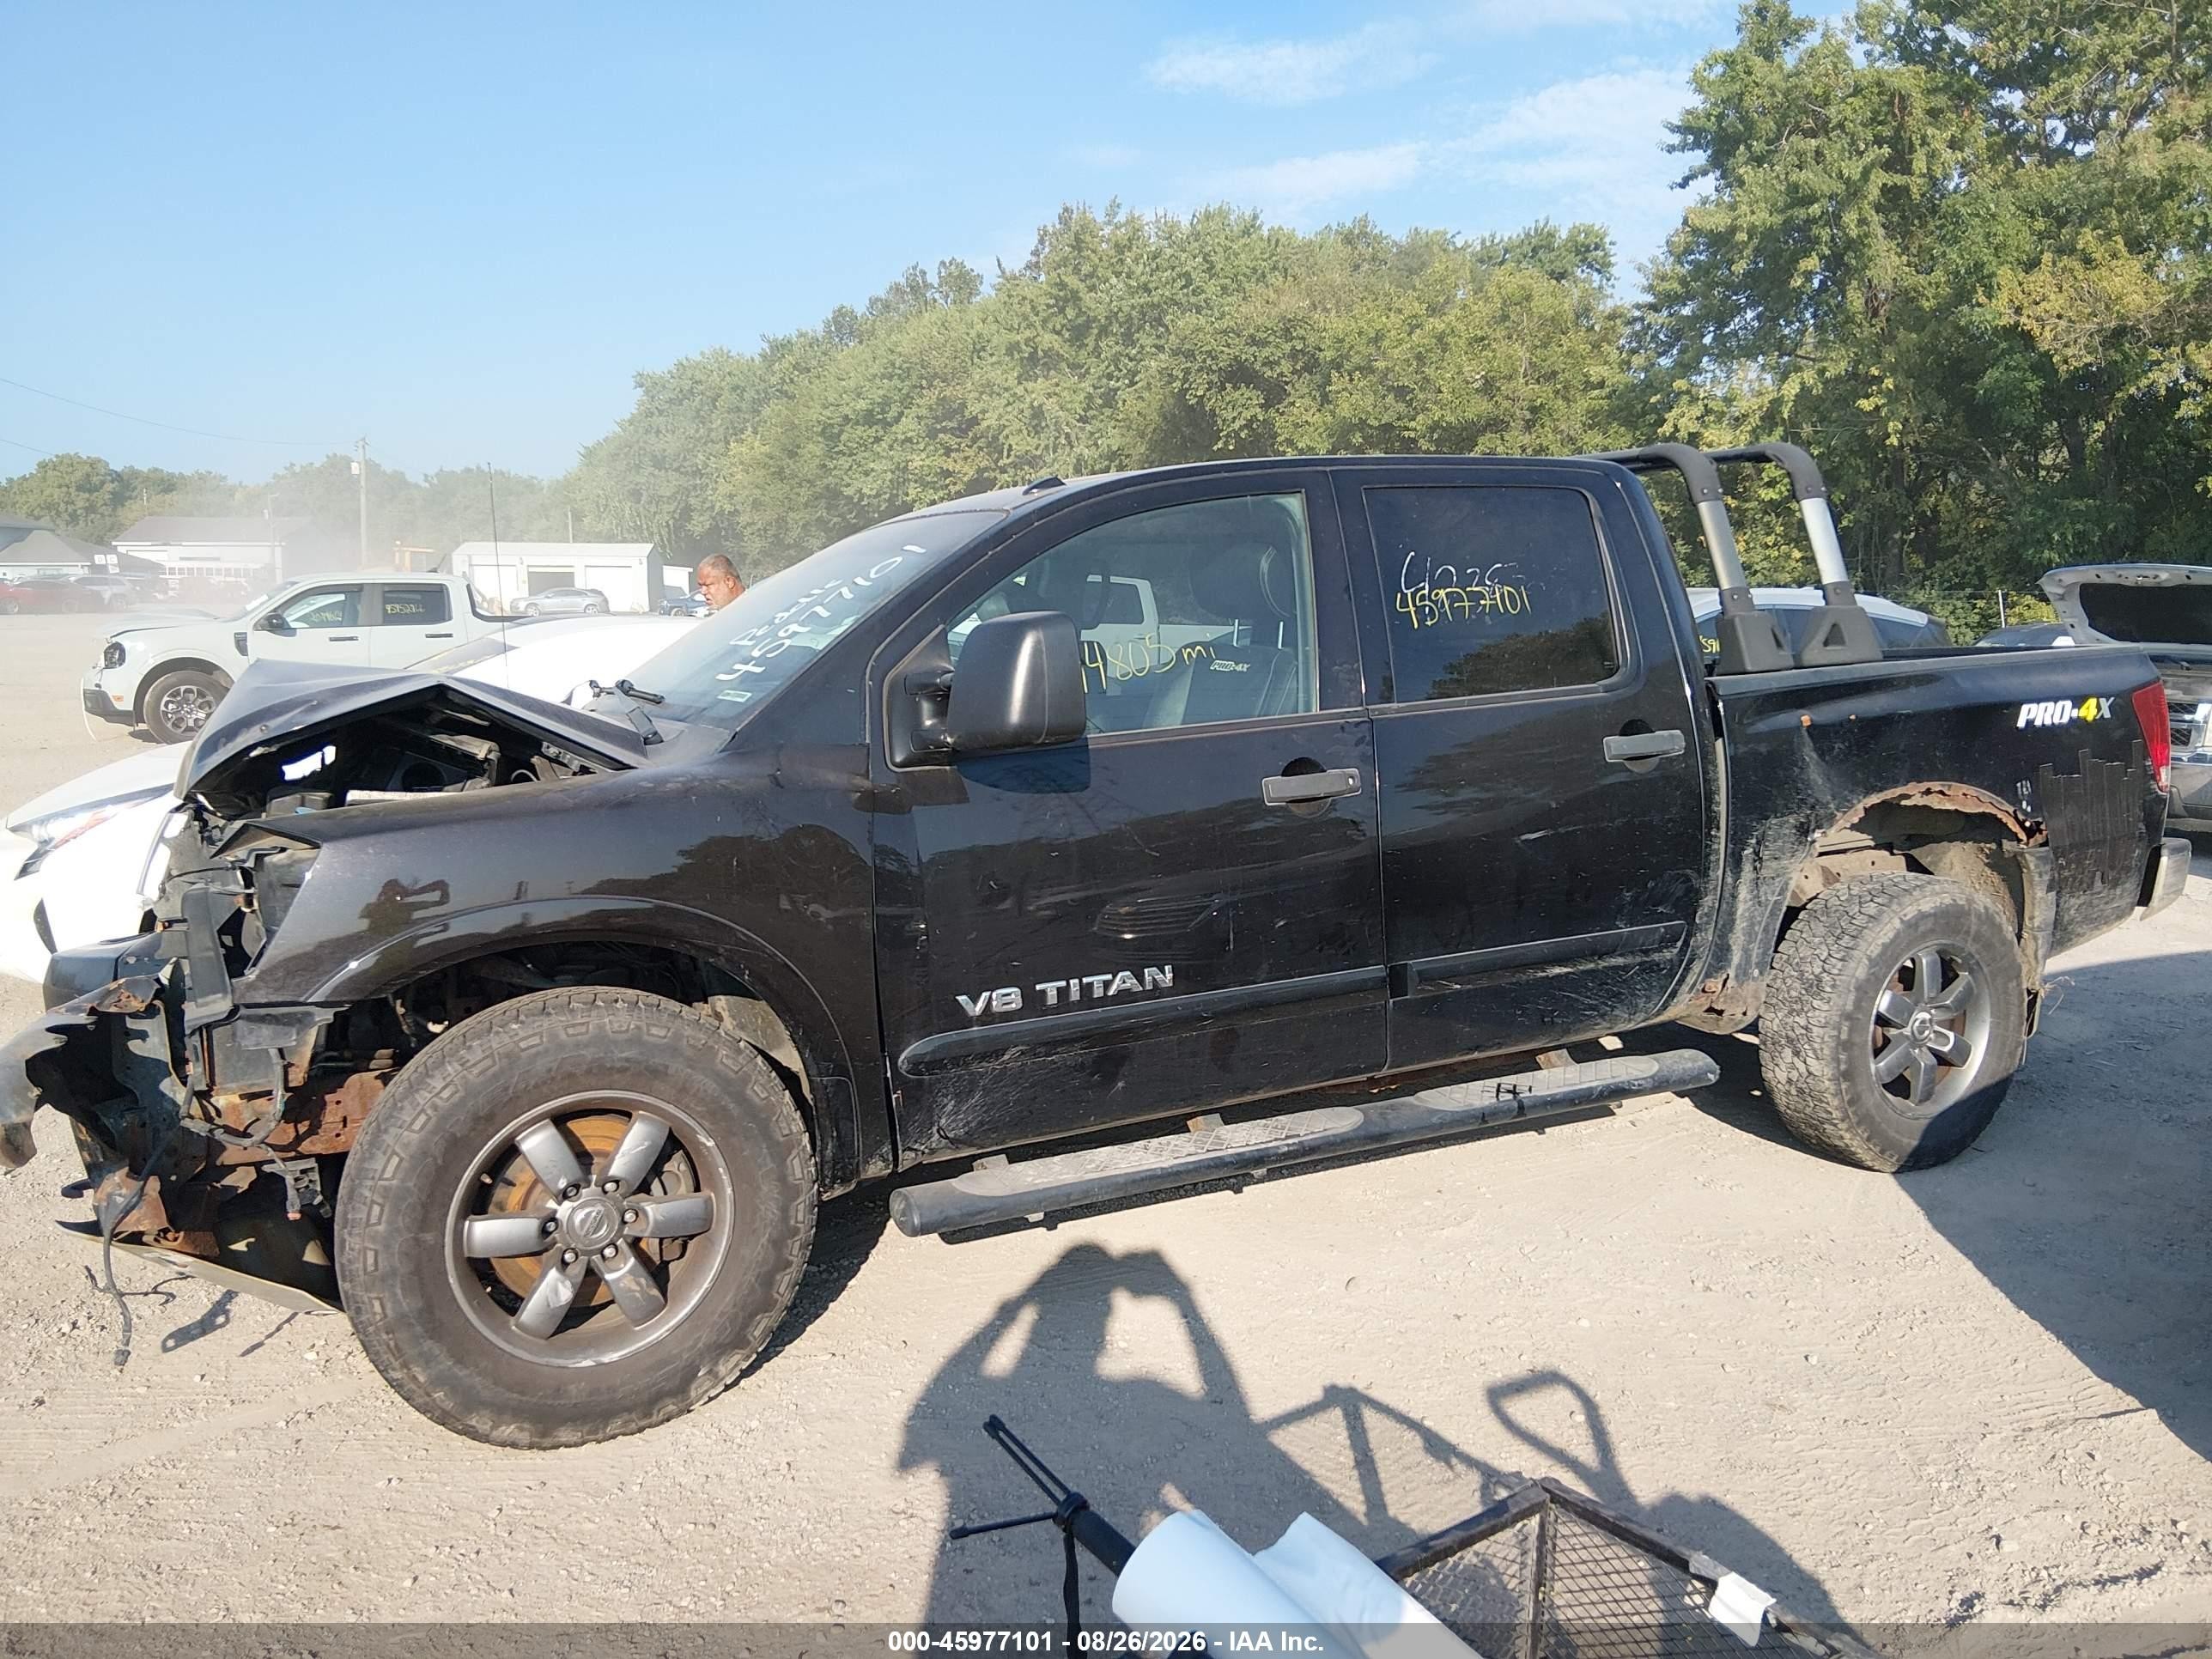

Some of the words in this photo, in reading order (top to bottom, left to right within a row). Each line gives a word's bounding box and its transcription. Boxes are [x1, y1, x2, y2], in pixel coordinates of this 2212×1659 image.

[715, 544, 927, 682] 45977101
[1396, 584, 1531, 629] 45977101
[2016, 696, 2115, 728] PRO-4X
[955, 987, 1024, 1018] V8
[1035, 964, 1174, 1006] TITAN
